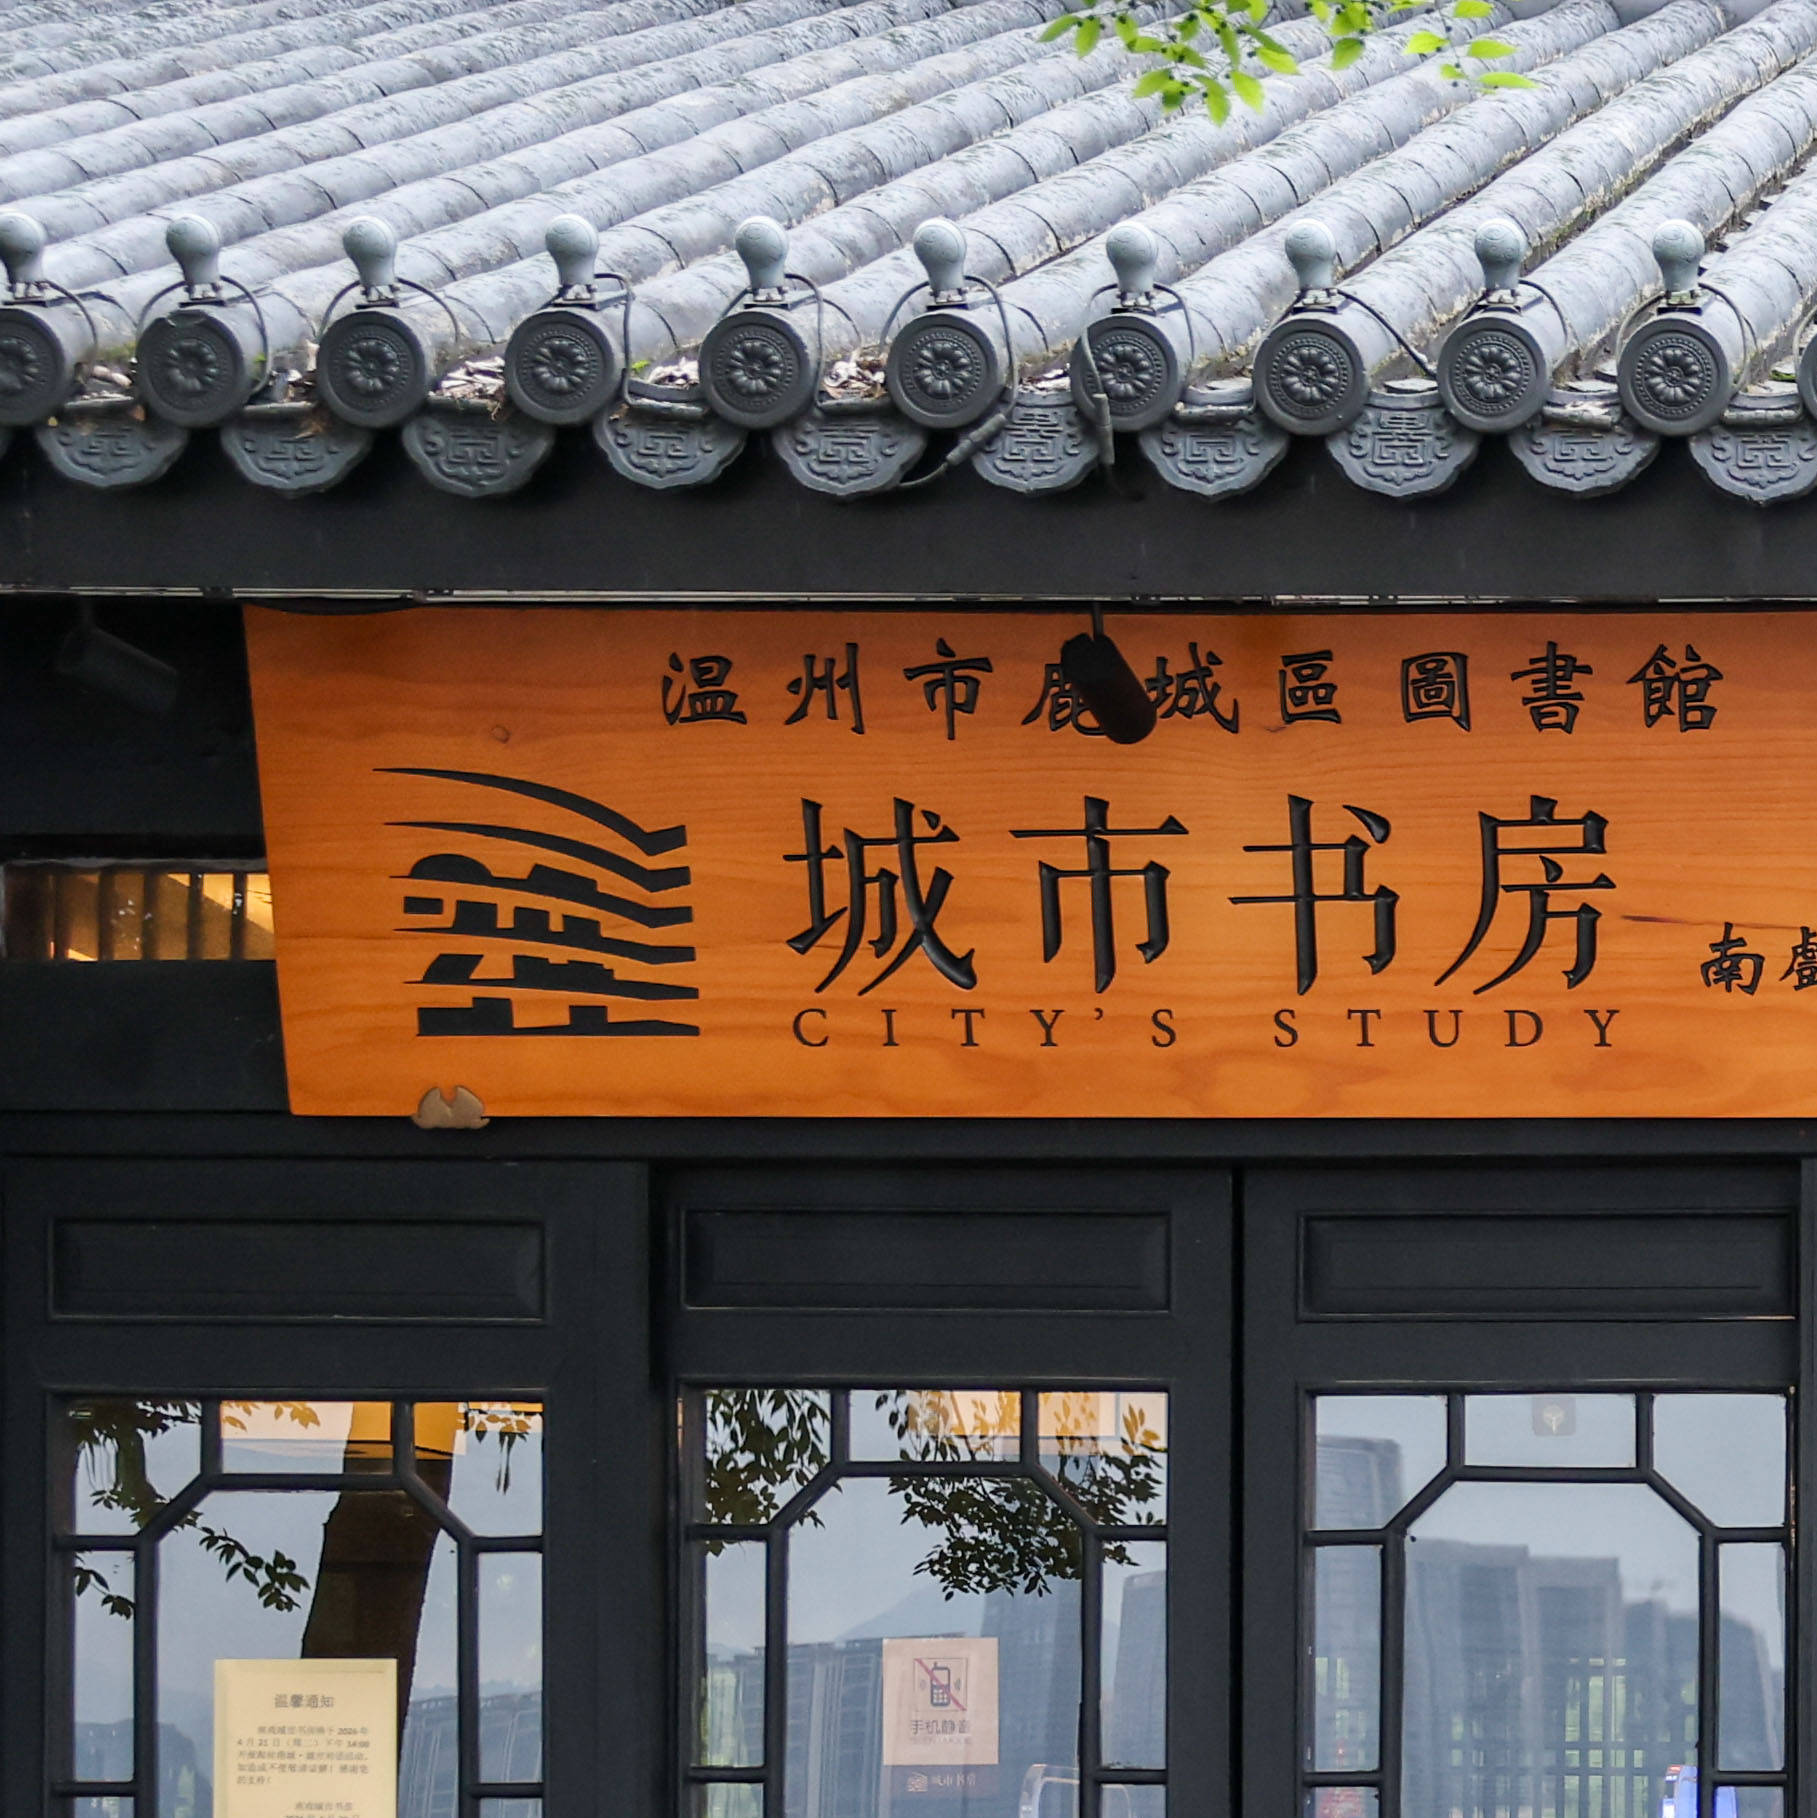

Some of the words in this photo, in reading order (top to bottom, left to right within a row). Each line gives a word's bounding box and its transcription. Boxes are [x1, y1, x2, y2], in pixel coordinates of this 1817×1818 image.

[783, 793, 1617, 996] 城市书房
[1274, 1008, 1620, 1049] STUDY
